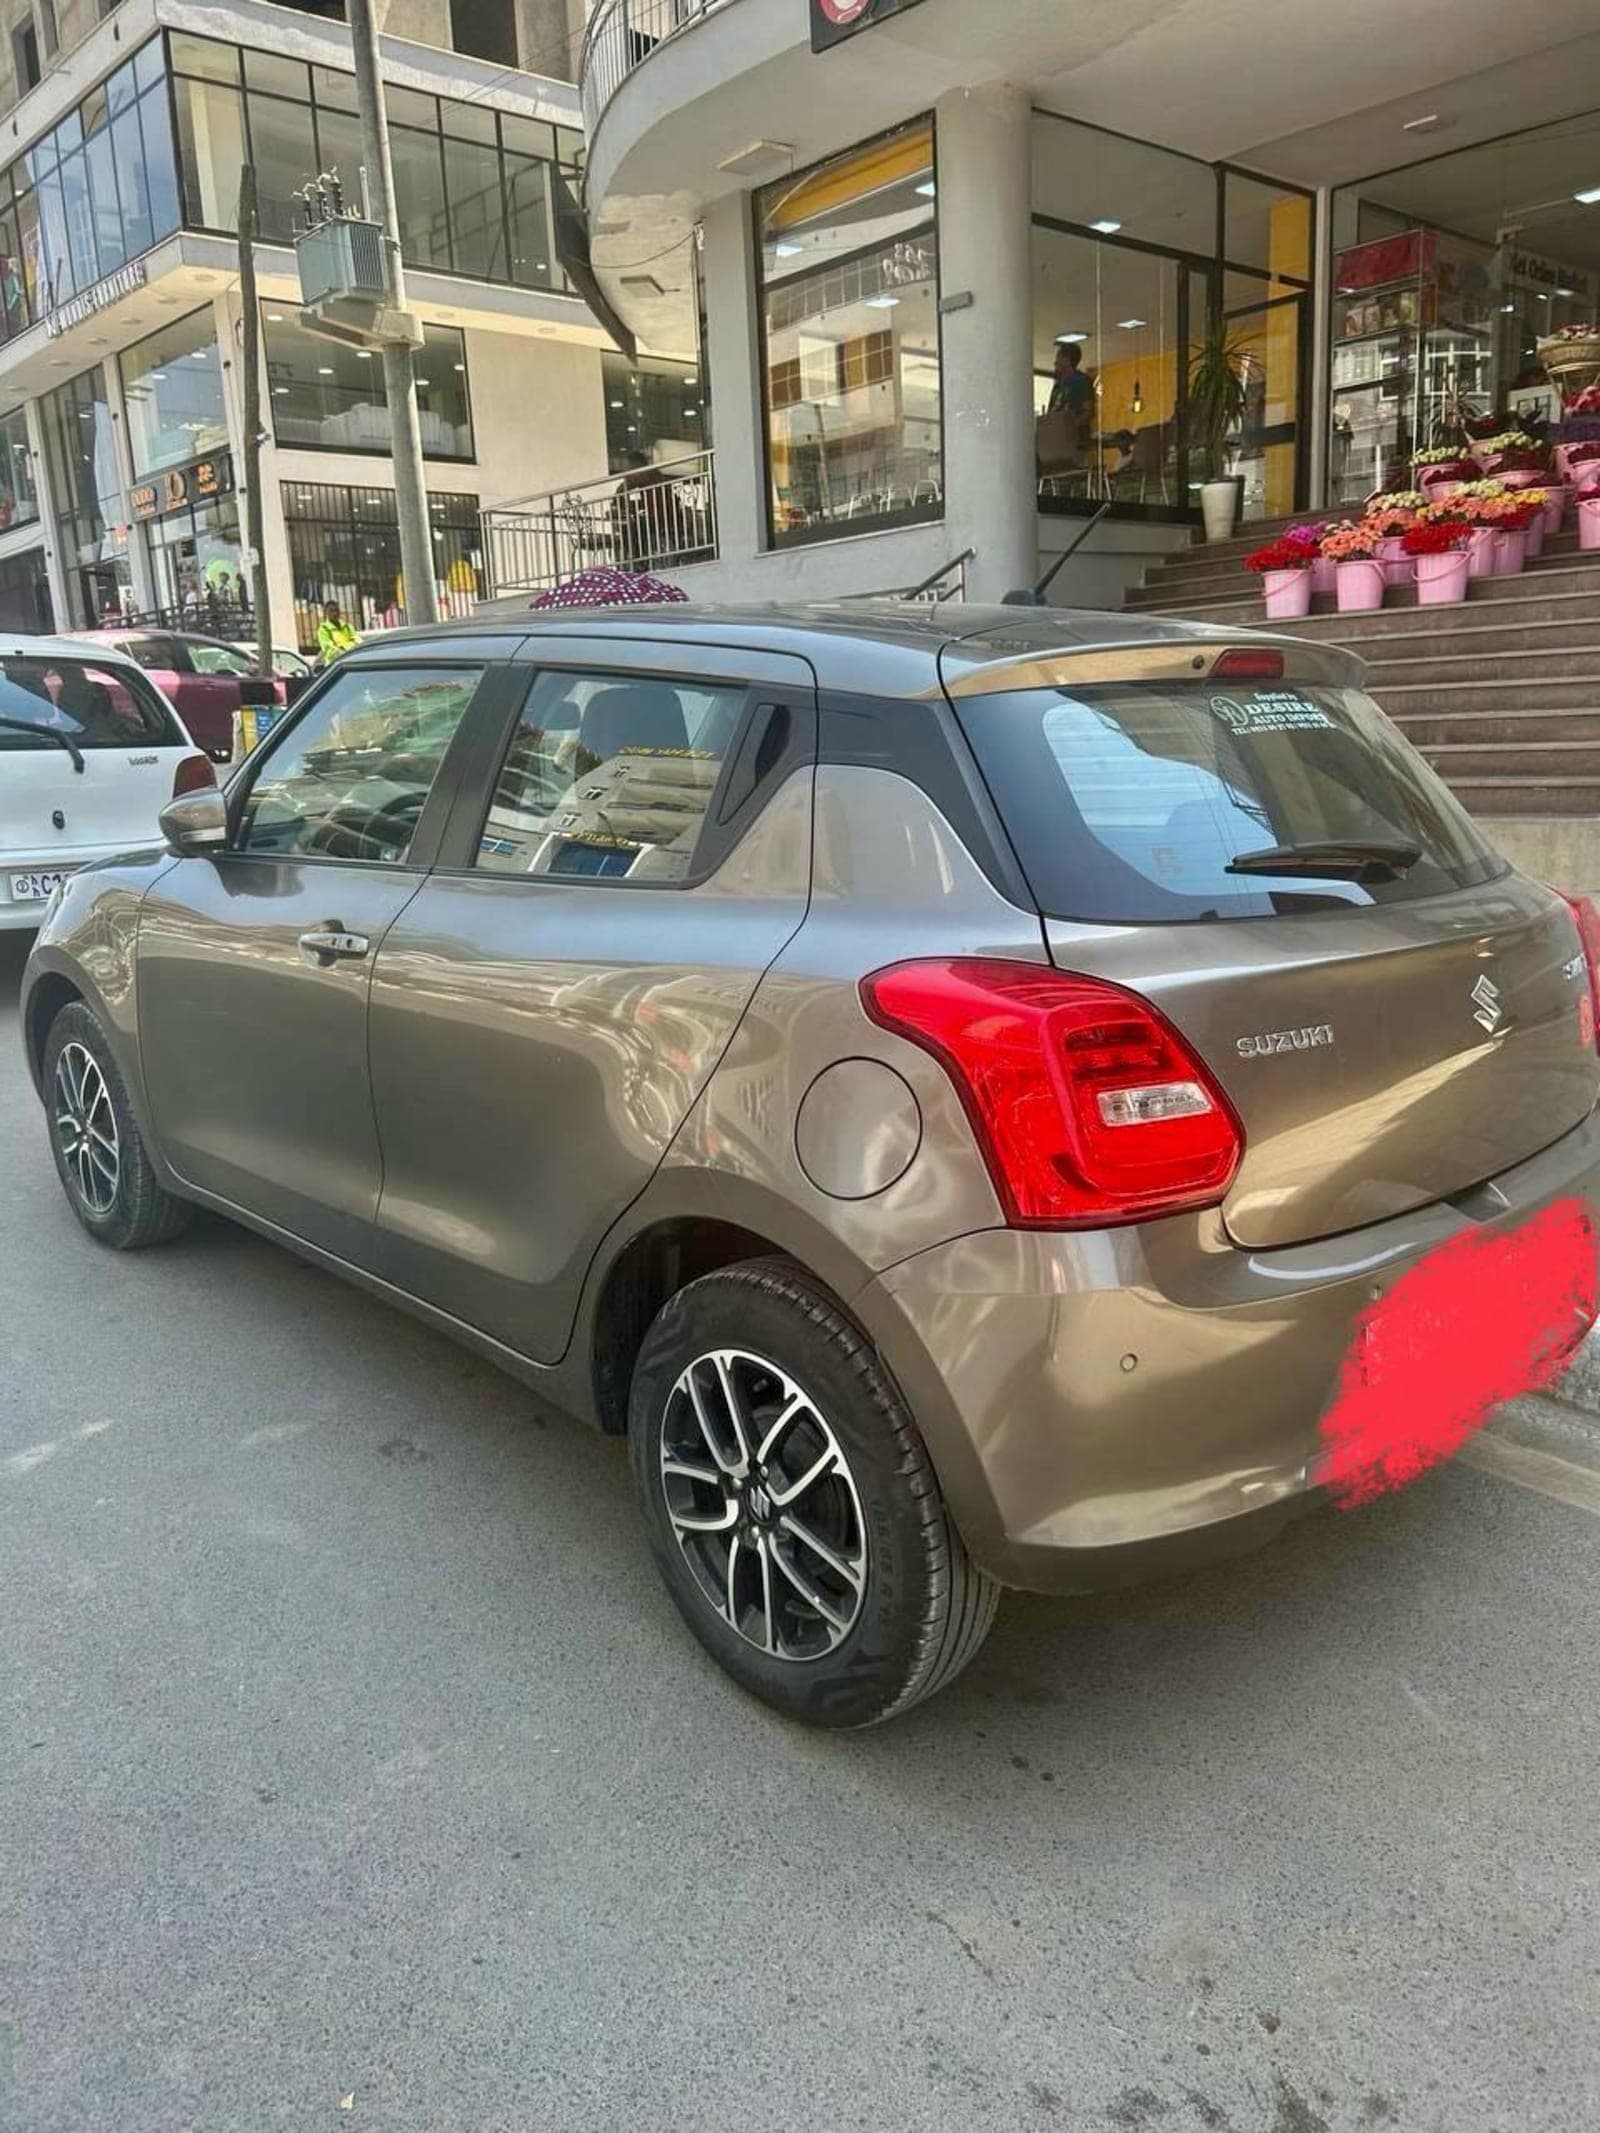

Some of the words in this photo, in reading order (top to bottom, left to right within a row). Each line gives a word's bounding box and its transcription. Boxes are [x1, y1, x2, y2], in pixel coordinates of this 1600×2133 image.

[1244, 702, 1320, 715] DESIRE
[1252, 715, 1286, 725] AUTO
[1236, 1024, 1334, 1059] SUZUKI
